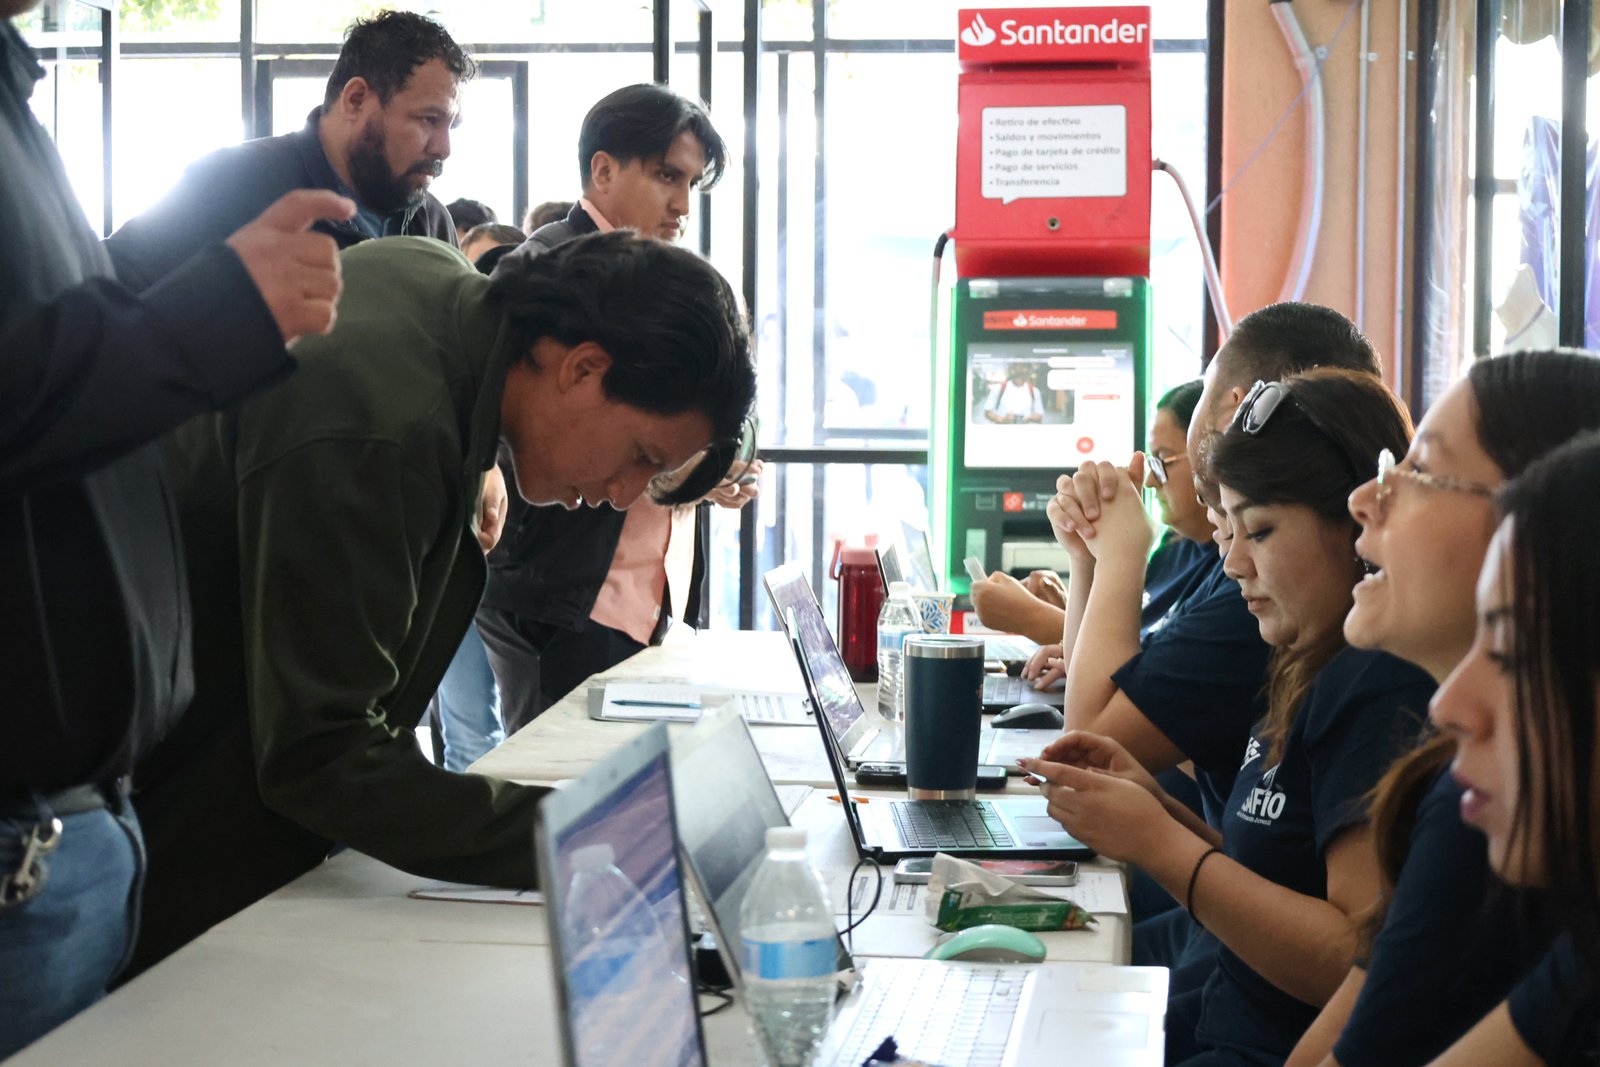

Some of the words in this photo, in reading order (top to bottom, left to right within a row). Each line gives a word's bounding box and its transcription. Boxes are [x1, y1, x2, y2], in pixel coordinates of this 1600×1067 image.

[1000, 18, 1148, 46] Santander
[995, 118, 1024, 127] Retiro
[1026, 117, 1039, 127] de
[1041, 116, 1081, 126] efectivo
[995, 133, 1026, 142] Saldos
[1029, 134, 1035, 143] y
[1037, 131, 1101, 141] movimientos
[995, 148, 1018, 158] Pago
[1021, 147, 1033, 156] de
[1036, 147, 1069, 158] tarjeta
[1072, 146, 1083, 156] de
[1086, 146, 1121, 155] crédito
[995, 163, 1018, 173] Pago
[1021, 162, 1033, 172] de
[1036, 162, 1078, 171] servicios
[995, 177, 1060, 187] Transferencia
[1028, 315, 1087, 327] Santander
